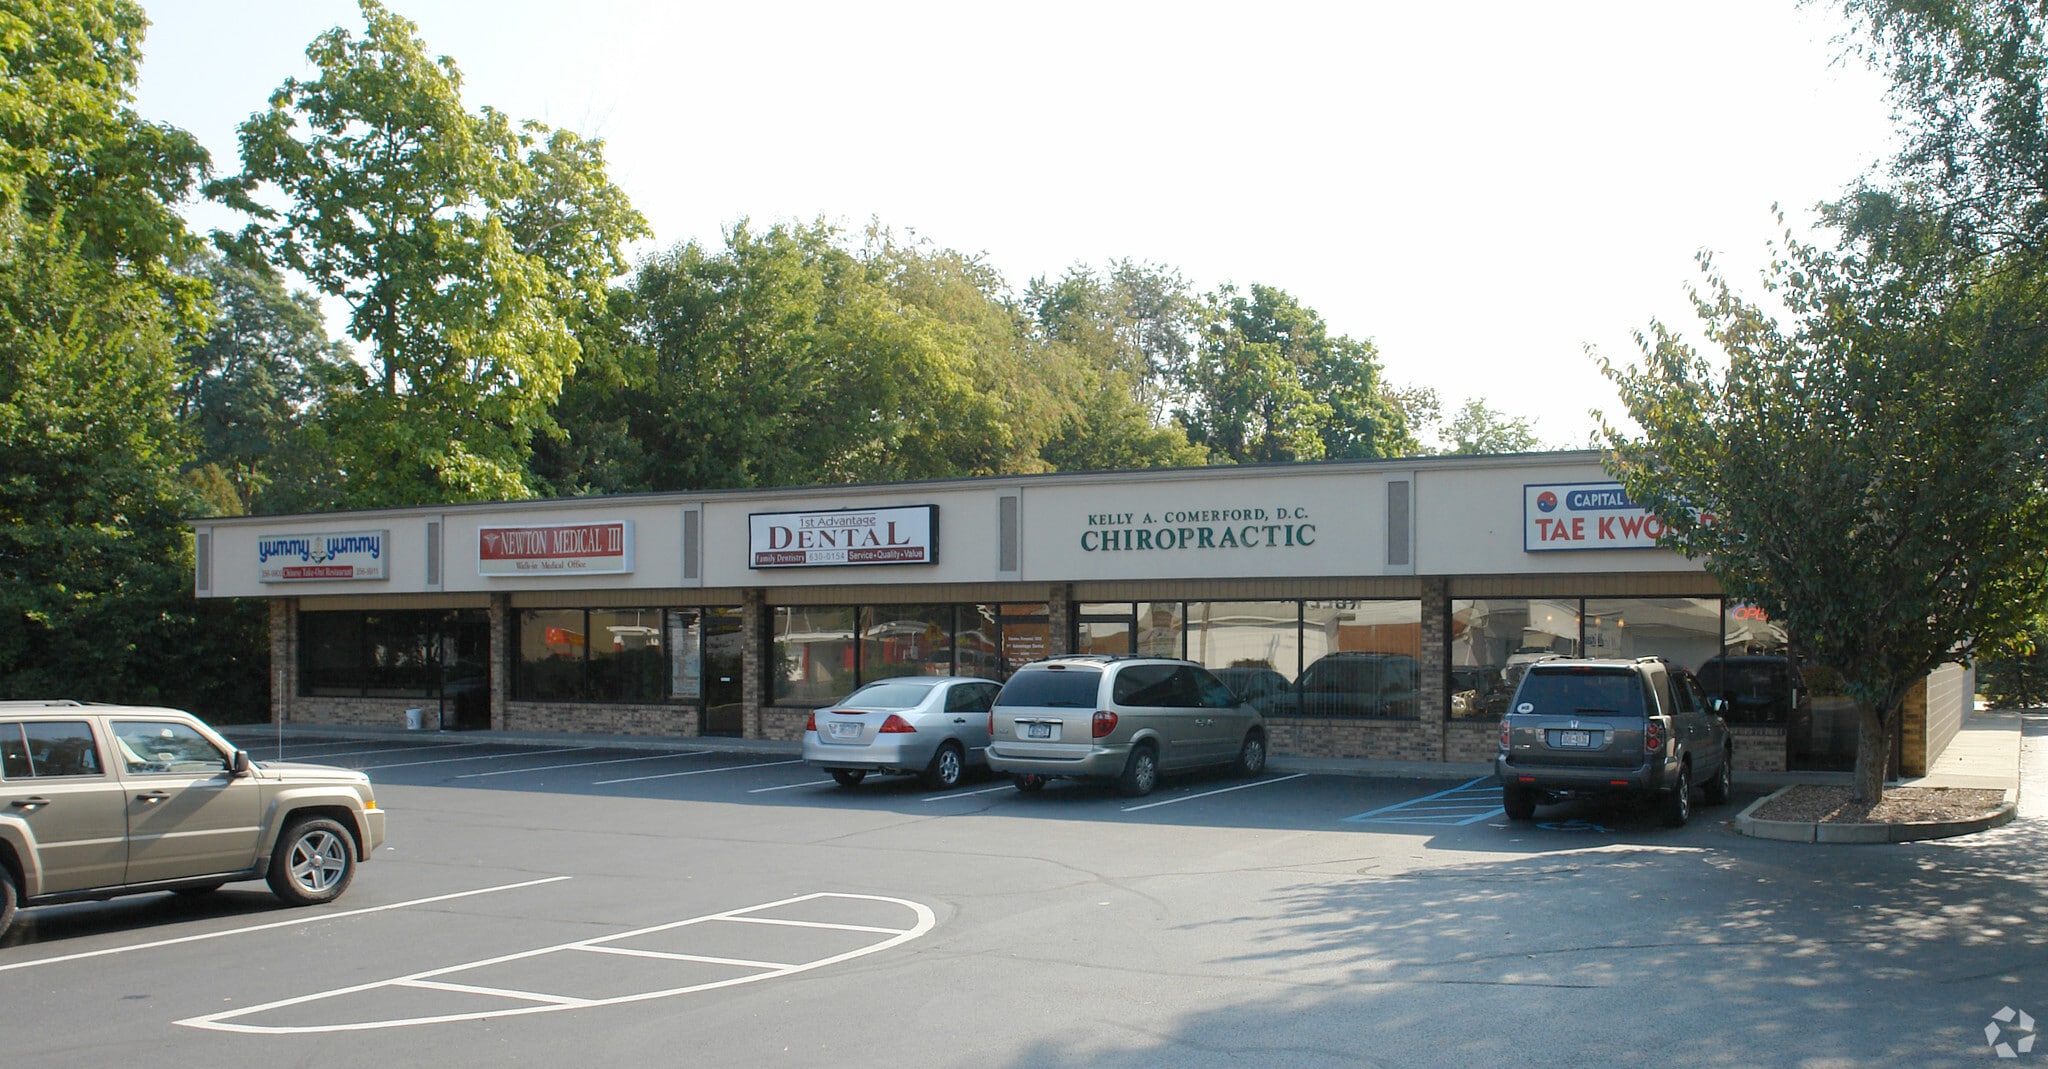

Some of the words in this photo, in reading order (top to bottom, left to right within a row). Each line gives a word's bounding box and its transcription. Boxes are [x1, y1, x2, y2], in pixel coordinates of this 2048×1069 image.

[1574, 493, 1624, 507] CAPITAL
[800, 518, 814, 527] 1st
[820, 516, 876, 528] Advantage
[1088, 513, 1133, 526] KELLY
[1143, 513, 1157, 524] A.
[1164, 508, 1269, 524] COMERFORD,
[768, 521, 911, 550] DENTAL
[1081, 524, 1316, 552] CHIROPRACTIC
[1535, 518, 1585, 541] TAE
[259, 540, 310, 563] yummy
[327, 536, 380, 559] yummy
[500, 531, 547, 555] NEWTON
[553, 528, 602, 554] MEDICAL
[541, 561, 564, 570] Medical
[567, 560, 587, 569] Office
[756, 554, 776, 564] Family
[777, 552, 805, 563] Dentistry
